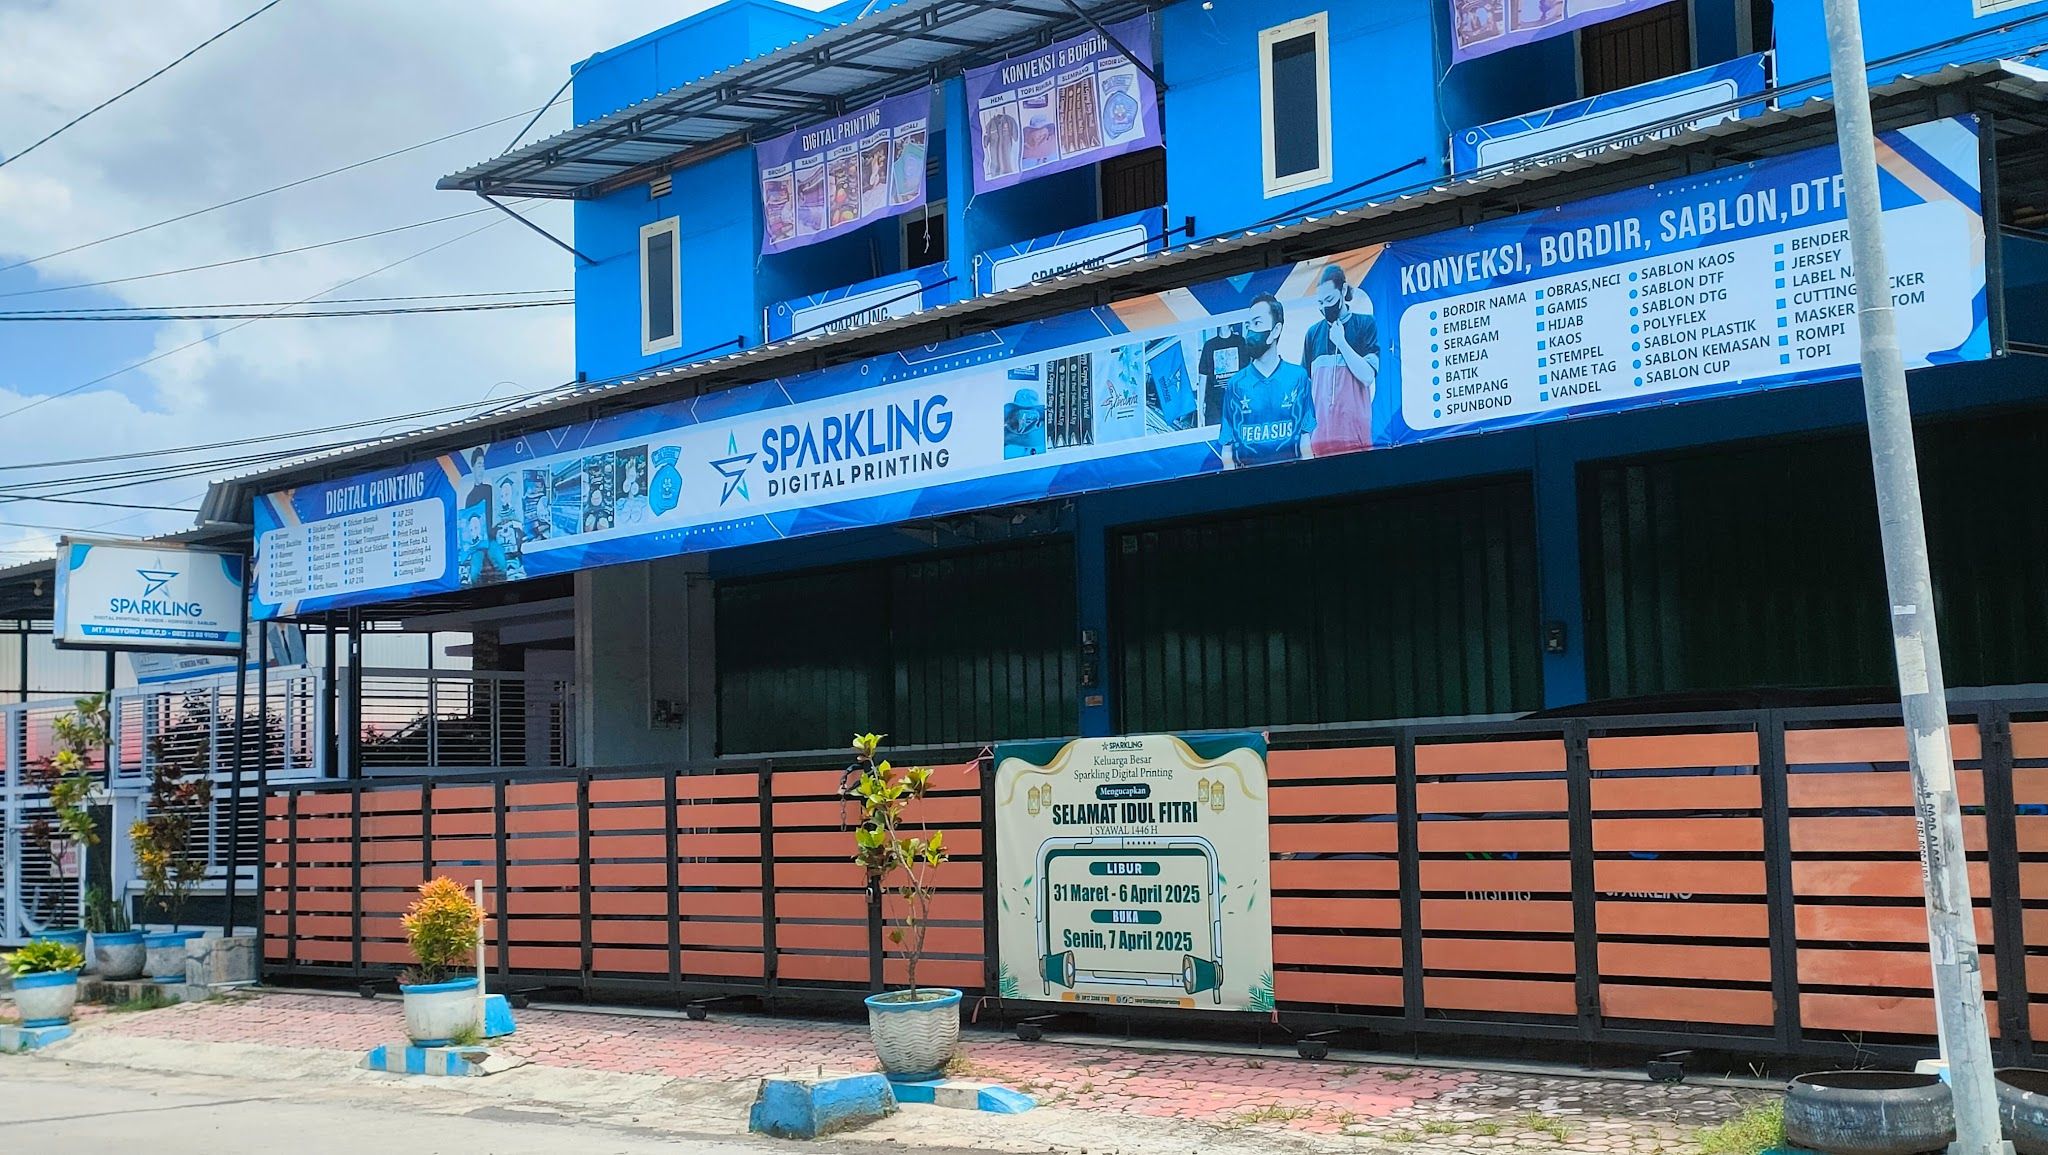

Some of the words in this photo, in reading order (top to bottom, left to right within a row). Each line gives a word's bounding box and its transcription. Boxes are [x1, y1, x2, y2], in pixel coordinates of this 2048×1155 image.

[1002, 55, 1056, 85] KONVEKSI
[1058, 50, 1066, 67] &
[990, 96, 1004, 104] HEM
[802, 127, 837, 151] DIGITAL
[838, 109, 880, 139] PRINTING
[1791, 229, 1851, 251] BENDER
[1401, 242, 1531, 296] KONVEKSI,
[1540, 217, 1651, 267] BORDIR,
[1641, 259, 1694, 280] SABLON
[1698, 252, 1735, 268] KAOS
[1791, 249, 1841, 269] JERSEY
[1642, 277, 1694, 297] SABLON
[1699, 271, 1725, 287] DTF
[1793, 269, 1836, 287] LABEL
[1642, 294, 1695, 314] SABLON
[1700, 288, 1727, 304] DTG
[1793, 283, 1857, 305] CUTTING
[1443, 300, 1486, 318] BORDIR
[1489, 292, 1526, 308] NAMA
[1547, 297, 1588, 315] GAMIS
[1795, 303, 1856, 324] MASKER
[1443, 315, 1491, 334] EMBLEM
[1548, 315, 1584, 332] HIJAB
[1643, 309, 1707, 332] POLYFLEX
[1444, 330, 1499, 350] SERAGAM
[1549, 332, 1582, 347] KAOS
[1644, 329, 1697, 349] SABLON
[1702, 318, 1756, 340] PLASTIK
[1796, 323, 1845, 342] ROMPI
[1445, 349, 1489, 367] KEMEJA
[1550, 346, 1604, 365] STEMPEL
[1645, 346, 1698, 366] SABLON
[1702, 335, 1771, 357] KEMASAN
[1797, 344, 1832, 361] TOPI
[1445, 367, 1479, 383] BATIK
[1550, 366, 1588, 382] NAME
[1591, 361, 1617, 374] TAG
[1646, 363, 1699, 384] SABLON
[1703, 359, 1730, 375] CUP
[1446, 378, 1508, 399] SLEMPANG
[1551, 381, 1602, 399] VANDEL
[1446, 395, 1512, 415] SPUNBOND
[762, 394, 953, 474] SPARKLING
[1242, 421, 1293, 441] PEGASUS
[769, 469, 845, 497] DIGITAL
[851, 449, 950, 483] PRINTING
[326, 484, 367, 515] DIGITAL
[370, 471, 424, 506] PRINTING
[110, 598, 203, 617] SPARKLING
[1109, 741, 1143, 749] SPARKLING
[1094, 755, 1128, 768] Keluarga
[1130, 754, 1152, 765] Besar
[1074, 769, 1110, 782] Sparkling
[1112, 767, 1139, 781] Digital
[1140, 767, 1173, 780] Printing
[1100, 786, 1147, 797] Mengucapkan
[1052, 803, 1118, 825] SELAMAT
[1121, 802, 1155, 824] IDUL
[1159, 801, 1198, 823] FITRI
[1095, 826, 1129, 835] SYAWAL
[1131, 826, 1151, 834] 1446
[1106, 863, 1142, 875] LIBUR
[1053, 884, 1068, 901] 31
[1071, 884, 1108, 902] Maret
[1119, 884, 1127, 903] 6
[1130, 884, 1162, 904] April
[1165, 885, 1200, 903] 2025
[1112, 910, 1139, 923] BUKA
[1063, 929, 1107, 950] Senin,
[1109, 930, 1116, 949] 7
[1119, 930, 1152, 951] April
[1155, 931, 1192, 951] 2025
